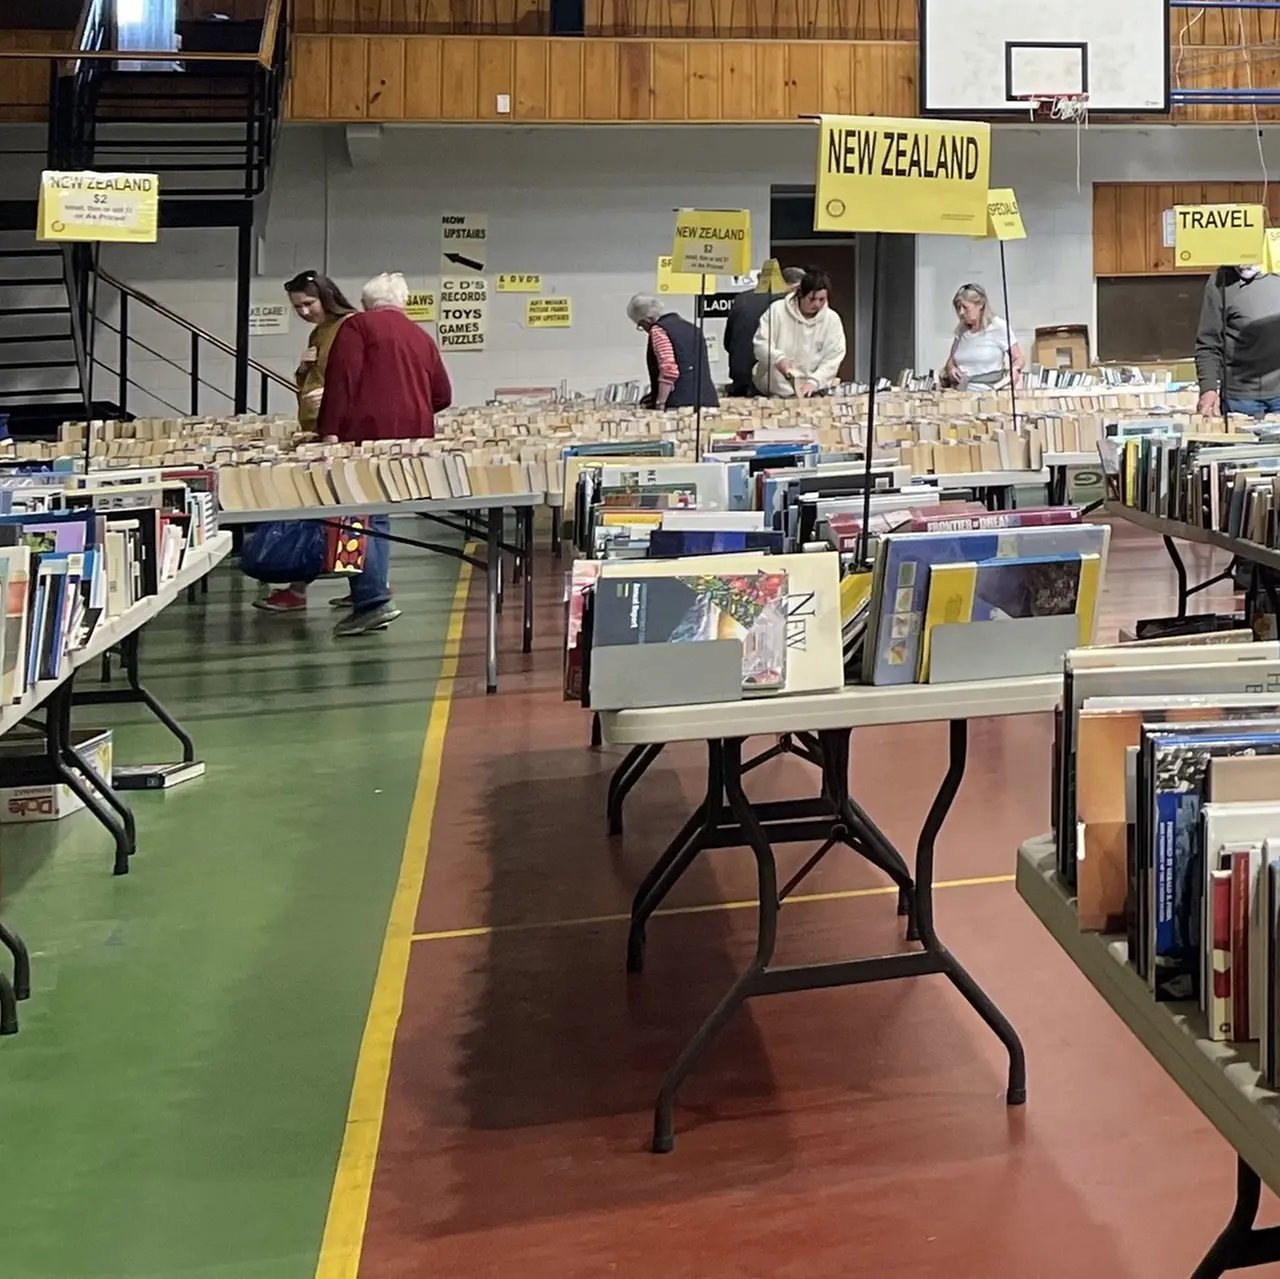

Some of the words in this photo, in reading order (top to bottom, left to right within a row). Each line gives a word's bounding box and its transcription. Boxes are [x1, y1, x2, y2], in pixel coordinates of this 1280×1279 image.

[828, 129, 877, 175] NEW
[881, 132, 978, 180] ZEALAND
[50, 176, 82, 189] NEW
[86, 177, 152, 192] ZEALAND
[1179, 210, 1254, 230] TRAVEL
[444, 228, 486, 239] UPSTAIRS
[676, 227, 698, 238] NEW
[700, 227, 744, 240] ZEALAND
[441, 291, 487, 302] RECORDS
[704, 299, 735, 310] LADI
[443, 309, 481, 319] TOYS
[439, 323, 479, 334] GAMES
[442, 334, 484, 346] PUZZLES
[927, 518, 972, 532] FRONTIER
[630, 606, 640, 628] Report
[8, 800, 52, 816] Dole
